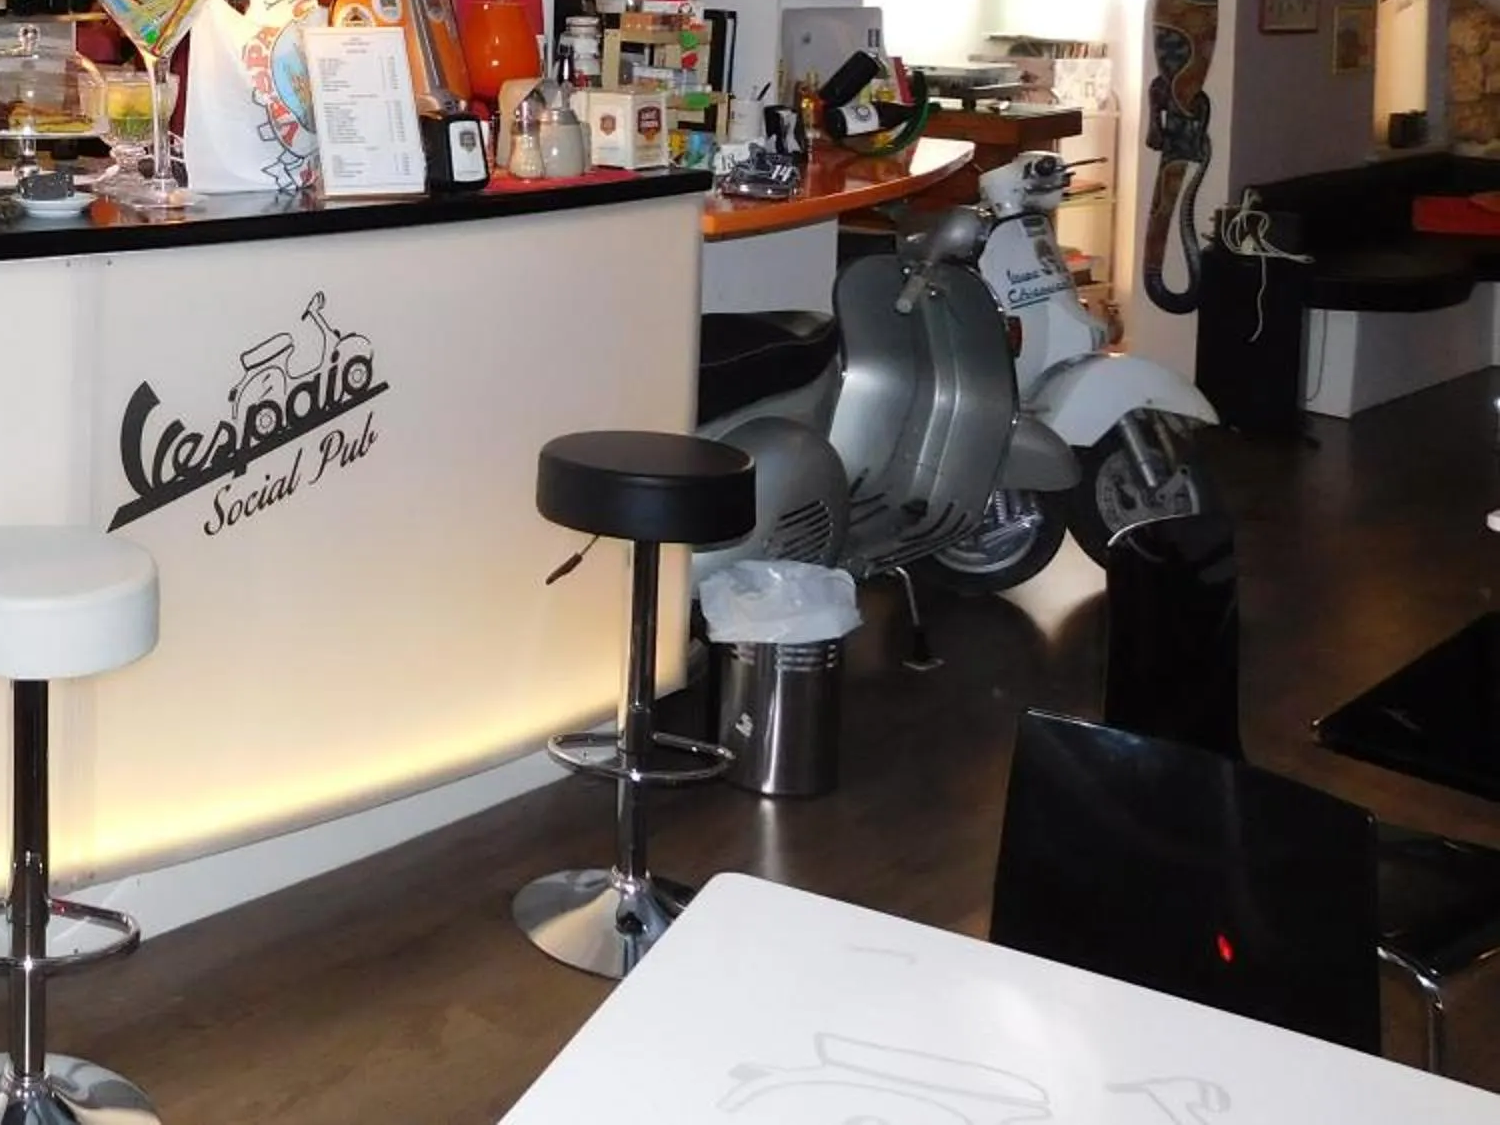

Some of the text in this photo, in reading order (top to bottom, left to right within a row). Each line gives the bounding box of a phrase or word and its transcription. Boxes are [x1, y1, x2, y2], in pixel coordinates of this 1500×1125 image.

[771, 164, 793, 181] 14
[107, 350, 389, 533] Vespaio
[203, 411, 380, 536] Social Pub
